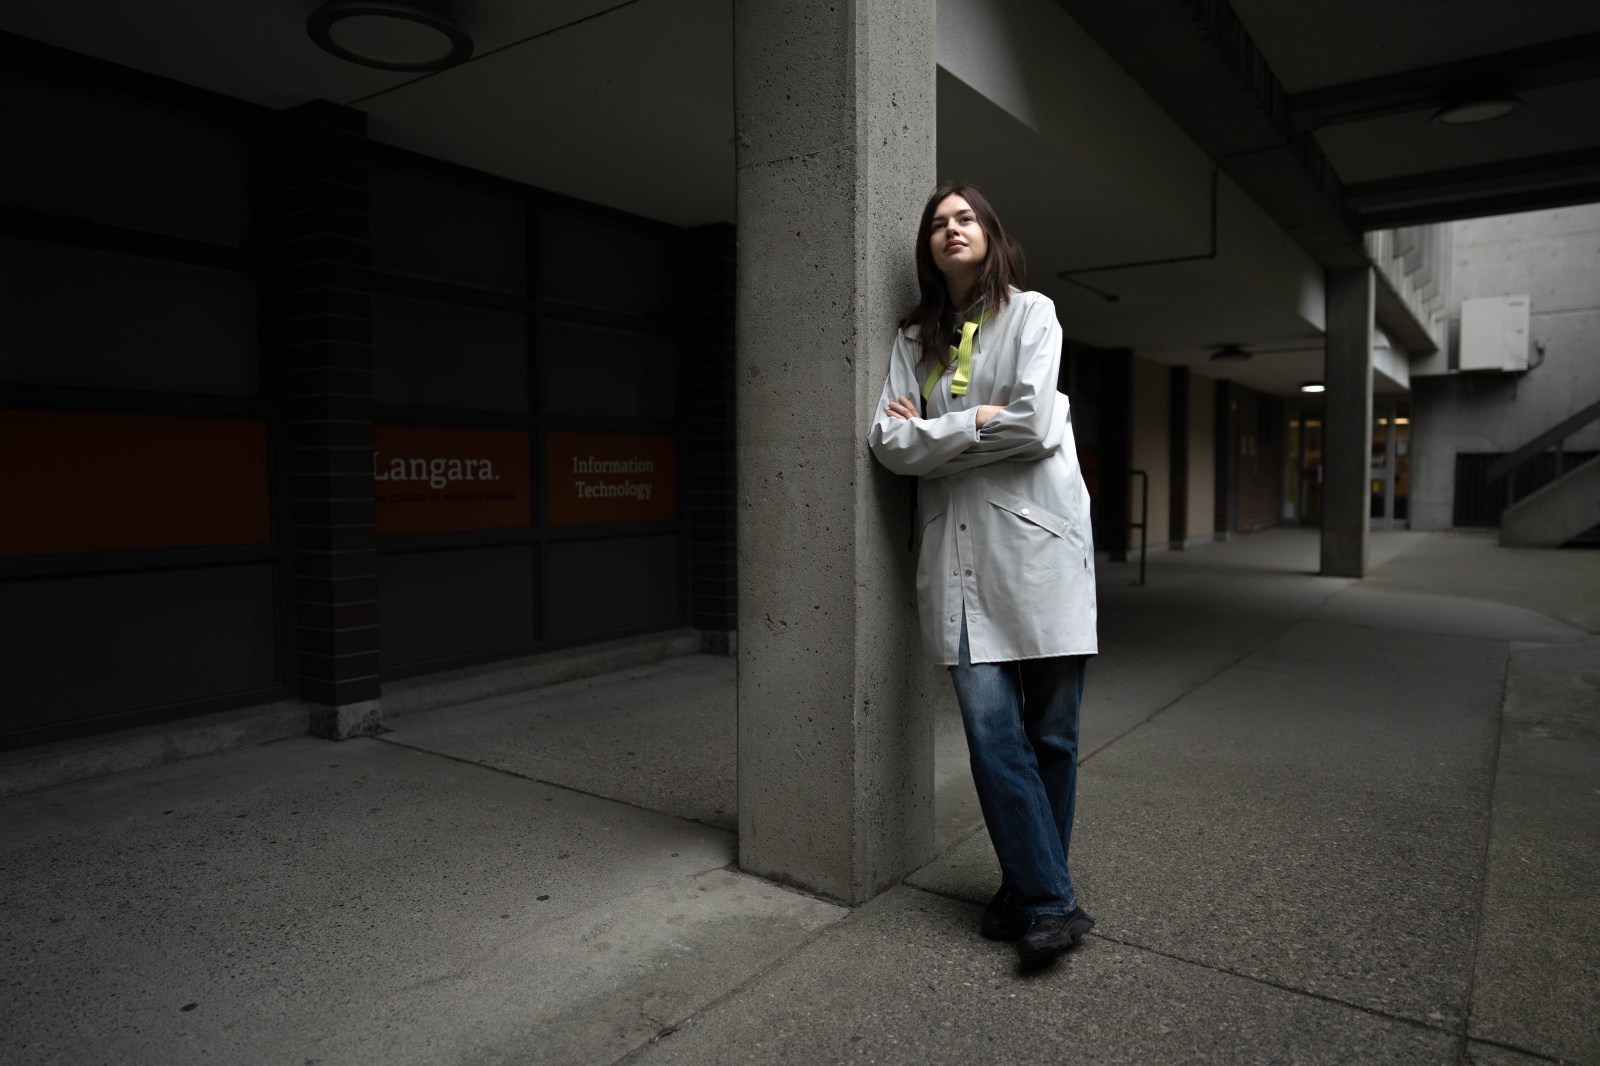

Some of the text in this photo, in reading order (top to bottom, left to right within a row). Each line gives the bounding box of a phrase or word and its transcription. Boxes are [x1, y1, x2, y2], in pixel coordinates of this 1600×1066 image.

[373, 451, 500, 489] Langara.
[572, 456, 655, 475] Information
[390, 493, 427, 503] COLLEGE
[575, 480, 653, 501] Technology
